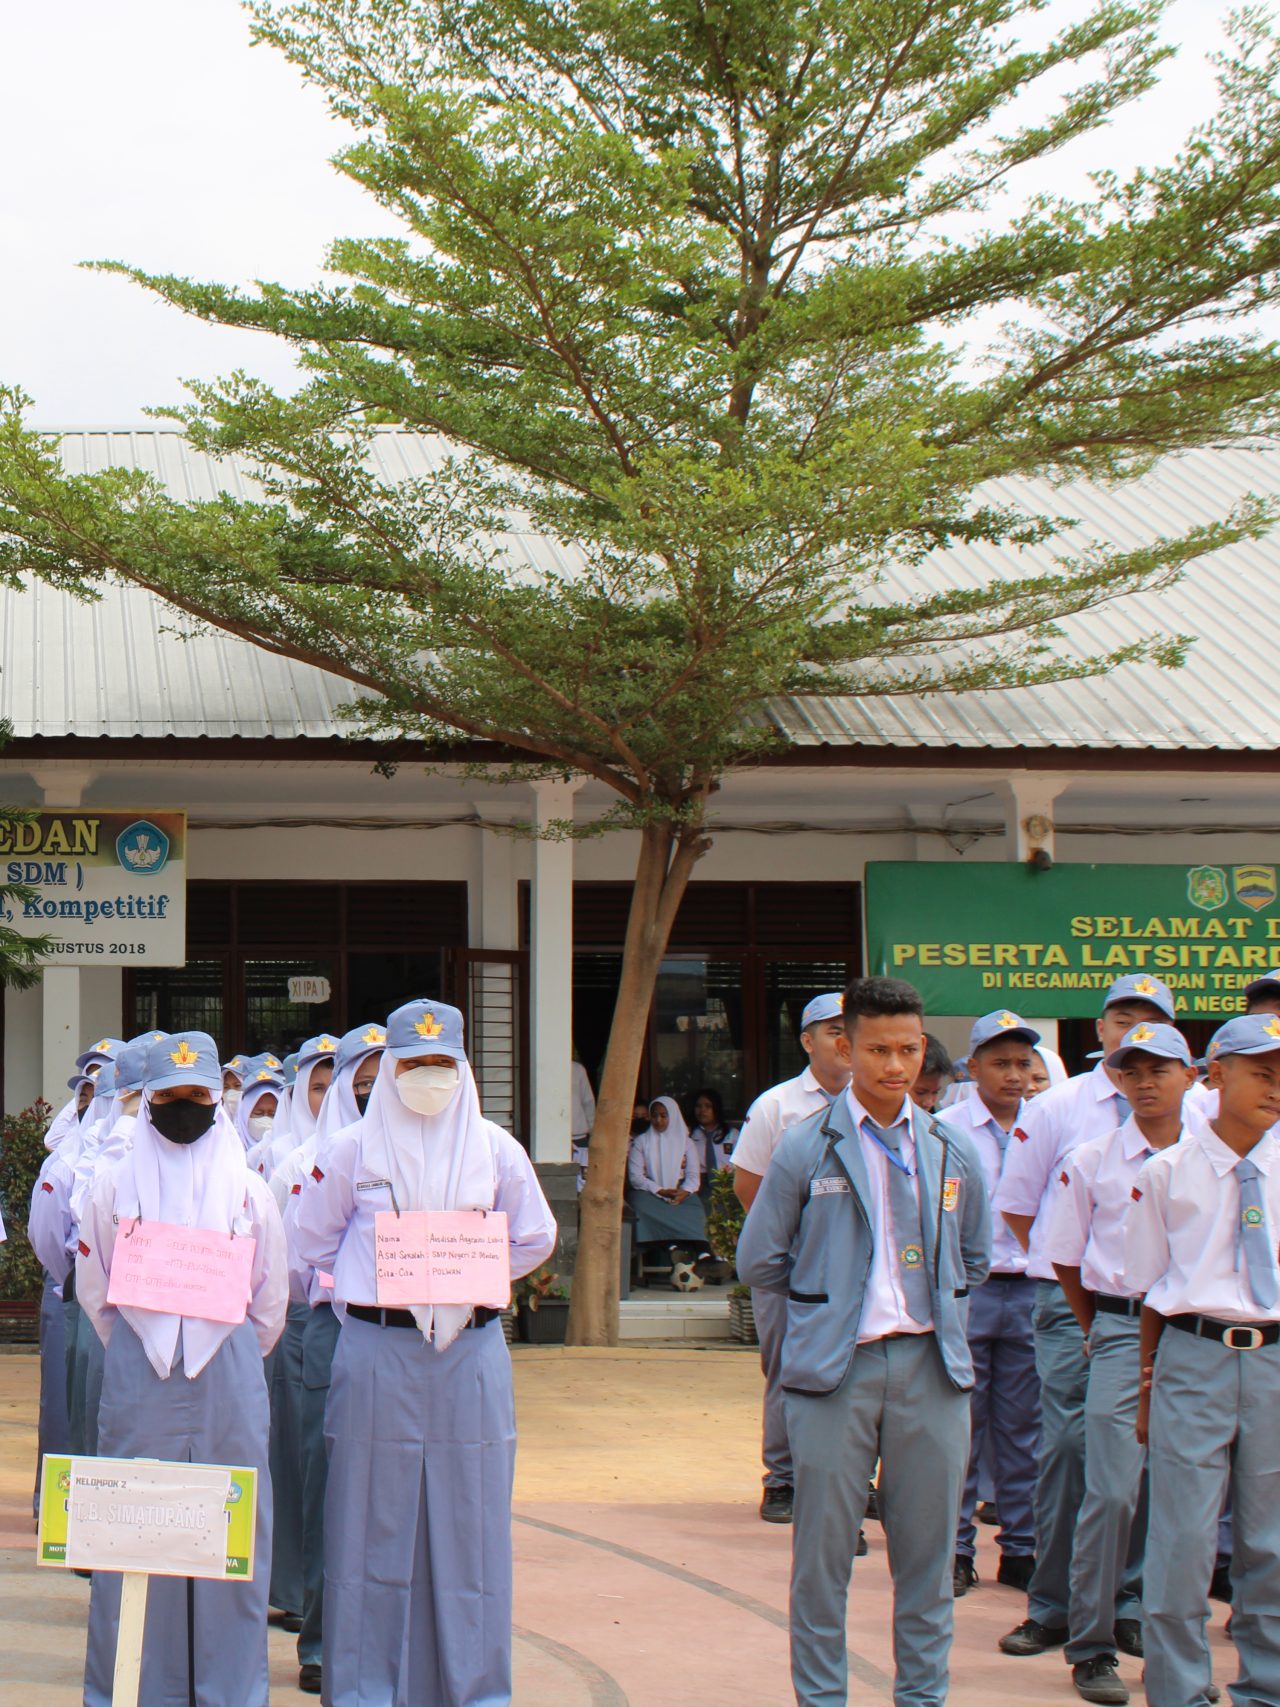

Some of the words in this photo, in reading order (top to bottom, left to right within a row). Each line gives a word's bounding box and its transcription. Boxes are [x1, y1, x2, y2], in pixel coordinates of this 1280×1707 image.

[7, 862, 68, 885] SDM
[22, 894, 170, 924] Kompetitif
[1071, 916, 1253, 938] SELAMAT
[42, 943, 105, 954] GUSTUS
[109, 943, 146, 954] 2018
[893, 943, 1069, 966] PESERTA
[303, 981, 318, 997] IPA
[982, 973, 1002, 989] DI
[1156, 973, 1205, 989] EDAN
[1194, 996, 1248, 1012] NEGE
[377, 1234, 401, 1244] Nama
[377, 1249, 397, 1260] Asal
[75, 1476, 120, 1488] KELOMPOK
[120, 1480, 127, 1489] 2
[74, 1501, 102, 1521] T.B.
[107, 1502, 207, 1530] SIMATUPANG
